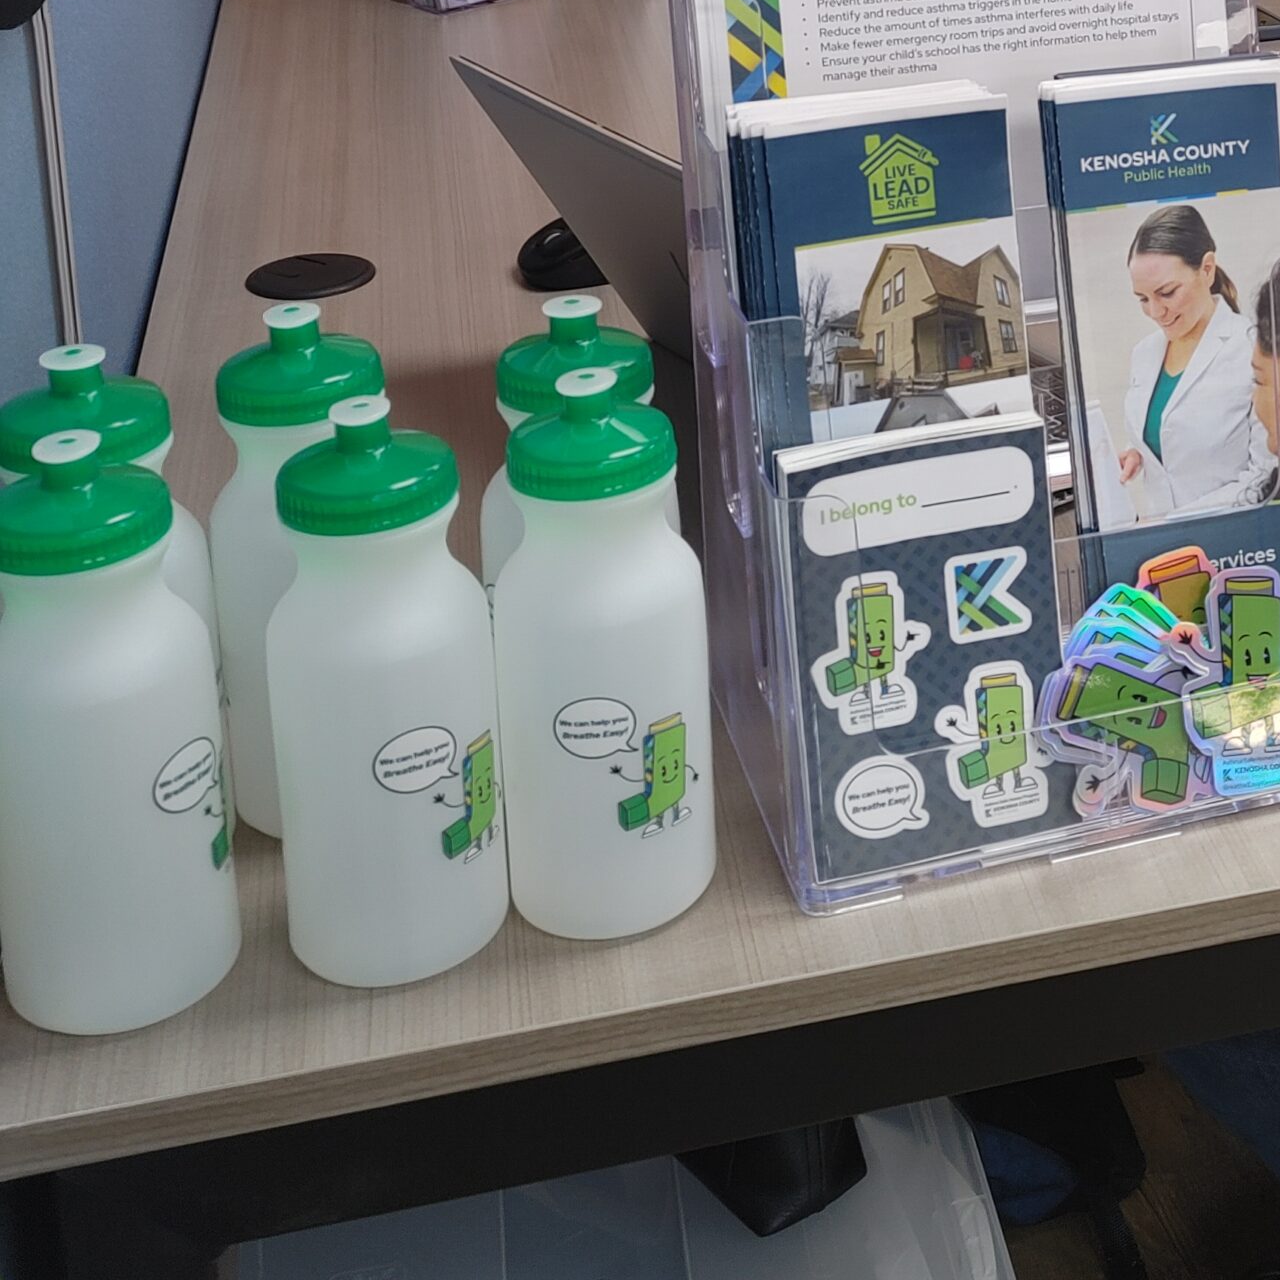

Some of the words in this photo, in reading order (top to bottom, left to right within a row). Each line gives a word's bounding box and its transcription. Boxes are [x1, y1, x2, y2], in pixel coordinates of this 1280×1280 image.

[817, 10, 860, 23] Identify
[863, 9, 884, 19] and
[886, 5, 924, 17] reduce
[926, 2, 965, 13] asthma
[819, 26, 861, 38] Reduce
[864, 23, 882, 33] the
[884, 20, 926, 32] amount
[928, 17, 941, 28] of
[942, 16, 972, 27] times
[975, 11, 1014, 25] asthma
[1015, 7, 1066, 20] interferes
[1068, 6, 1090, 16] with
[1092, 3, 1116, 15] daily
[1117, 1, 1134, 11] life
[820, 41, 850, 52] Make
[852, 38, 883, 49] fewer
[886, 33, 947, 47] emergency
[950, 31, 978, 40] room
[981, 26, 1005, 39] trips
[1006, 24, 1026, 35] and
[1028, 22, 1056, 33] avoid
[1058, 16, 1108, 31] overnight
[1110, 13, 1151, 27] hospital
[1153, 11, 1179, 22] stays
[821, 56, 860, 67] Ensure
[862, 53, 886, 65] your
[925, 46, 960, 58] school
[962, 44, 981, 53] has
[983, 41, 1001, 52] the
[1003, 38, 1028, 51] right
[1030, 34, 1090, 48] information
[1092, 32, 1104, 42] to
[1105, 29, 1128, 41] help
[1130, 27, 1157, 38] them
[823, 70, 867, 82] manage
[870, 66, 894, 77] their
[897, 63, 937, 74] asthma
[1080, 149, 1170, 173] KENOSHA
[1173, 140, 1250, 162] COUNTY
[884, 163, 916, 179] LIVE
[1123, 168, 1165, 183] Public
[1168, 162, 1212, 178] Health
[872, 176, 930, 201] LEAD
[887, 196, 919, 210] SAFE
[820, 510, 825, 525] I
[830, 499, 893, 523] belong
[896, 493, 917, 508] to
[1209, 548, 1277, 570] ervices
[876, 786, 894, 795] help
[895, 783, 910, 792] you
[852, 802, 886, 814] Breathe
